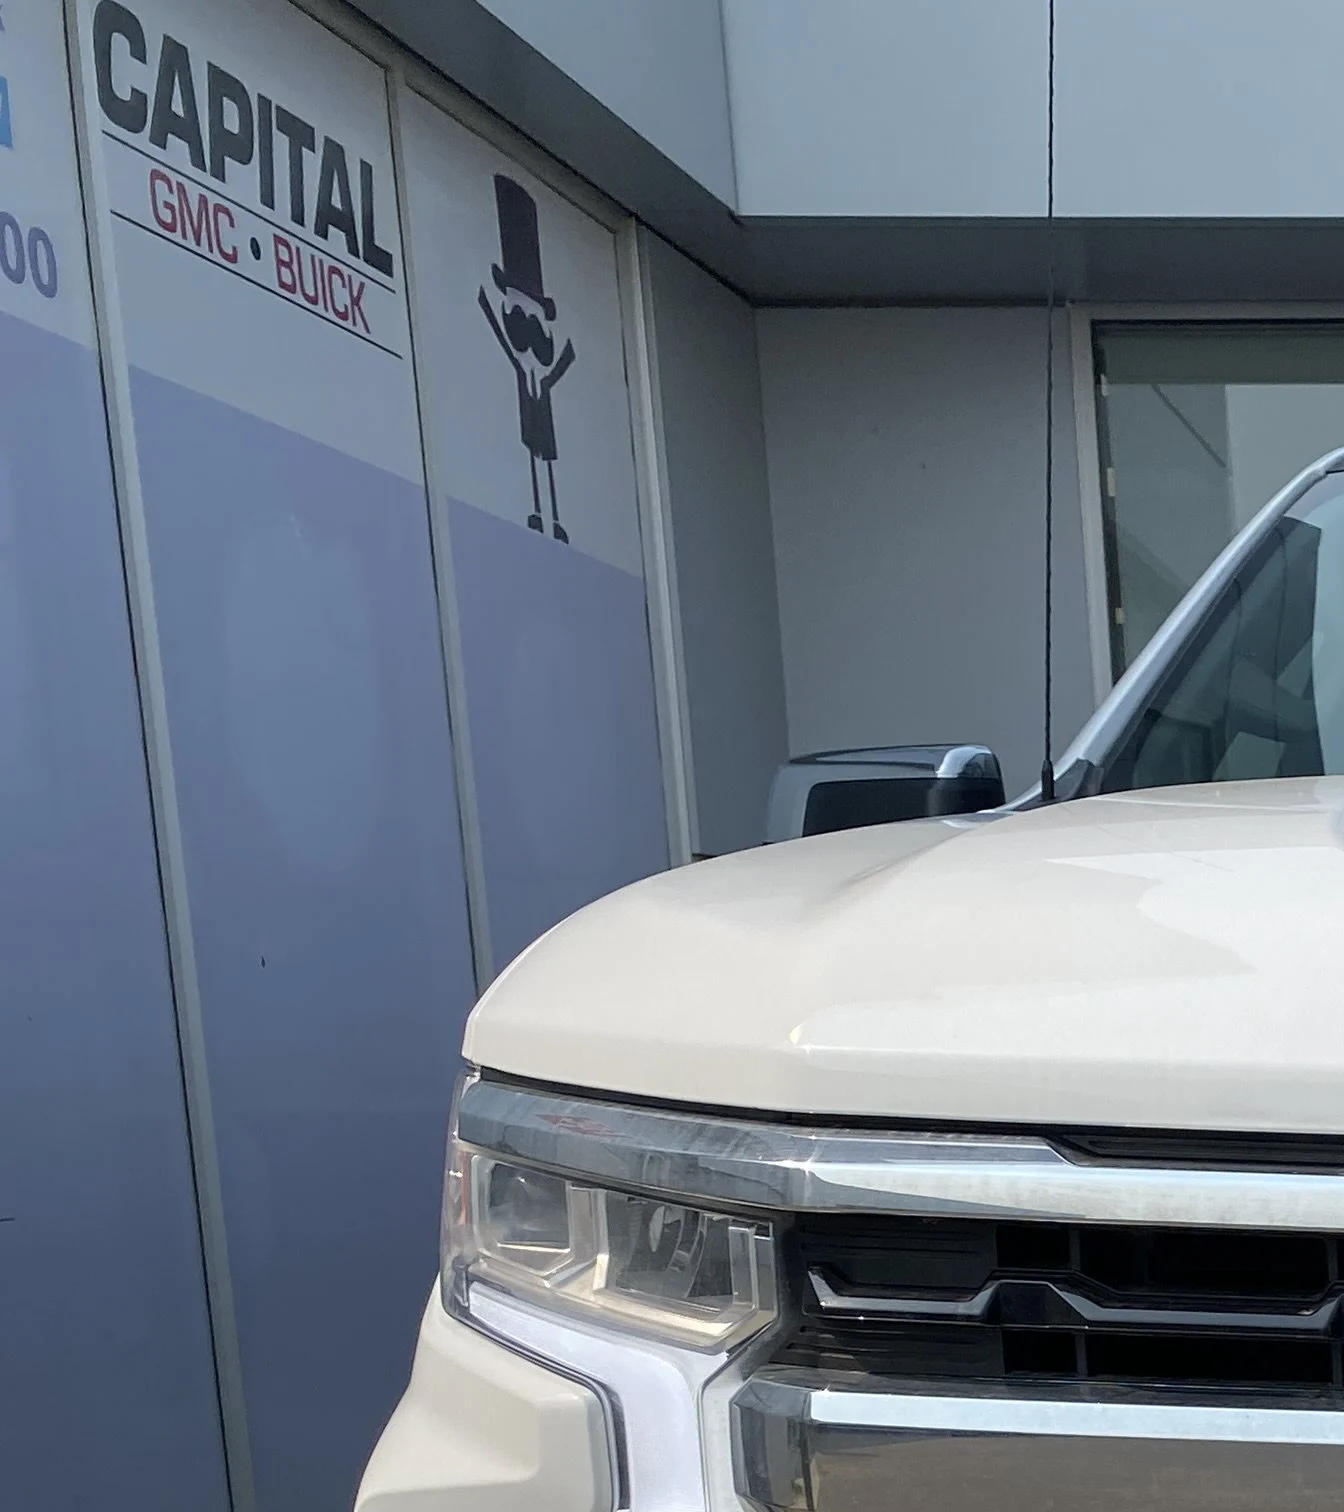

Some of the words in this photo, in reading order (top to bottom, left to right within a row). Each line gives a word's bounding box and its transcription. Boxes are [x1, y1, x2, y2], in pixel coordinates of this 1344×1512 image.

[93, 1, 394, 278] CAPITAL
[149, 168, 239, 264] GMC
[272, 234, 371, 334] BUICK
